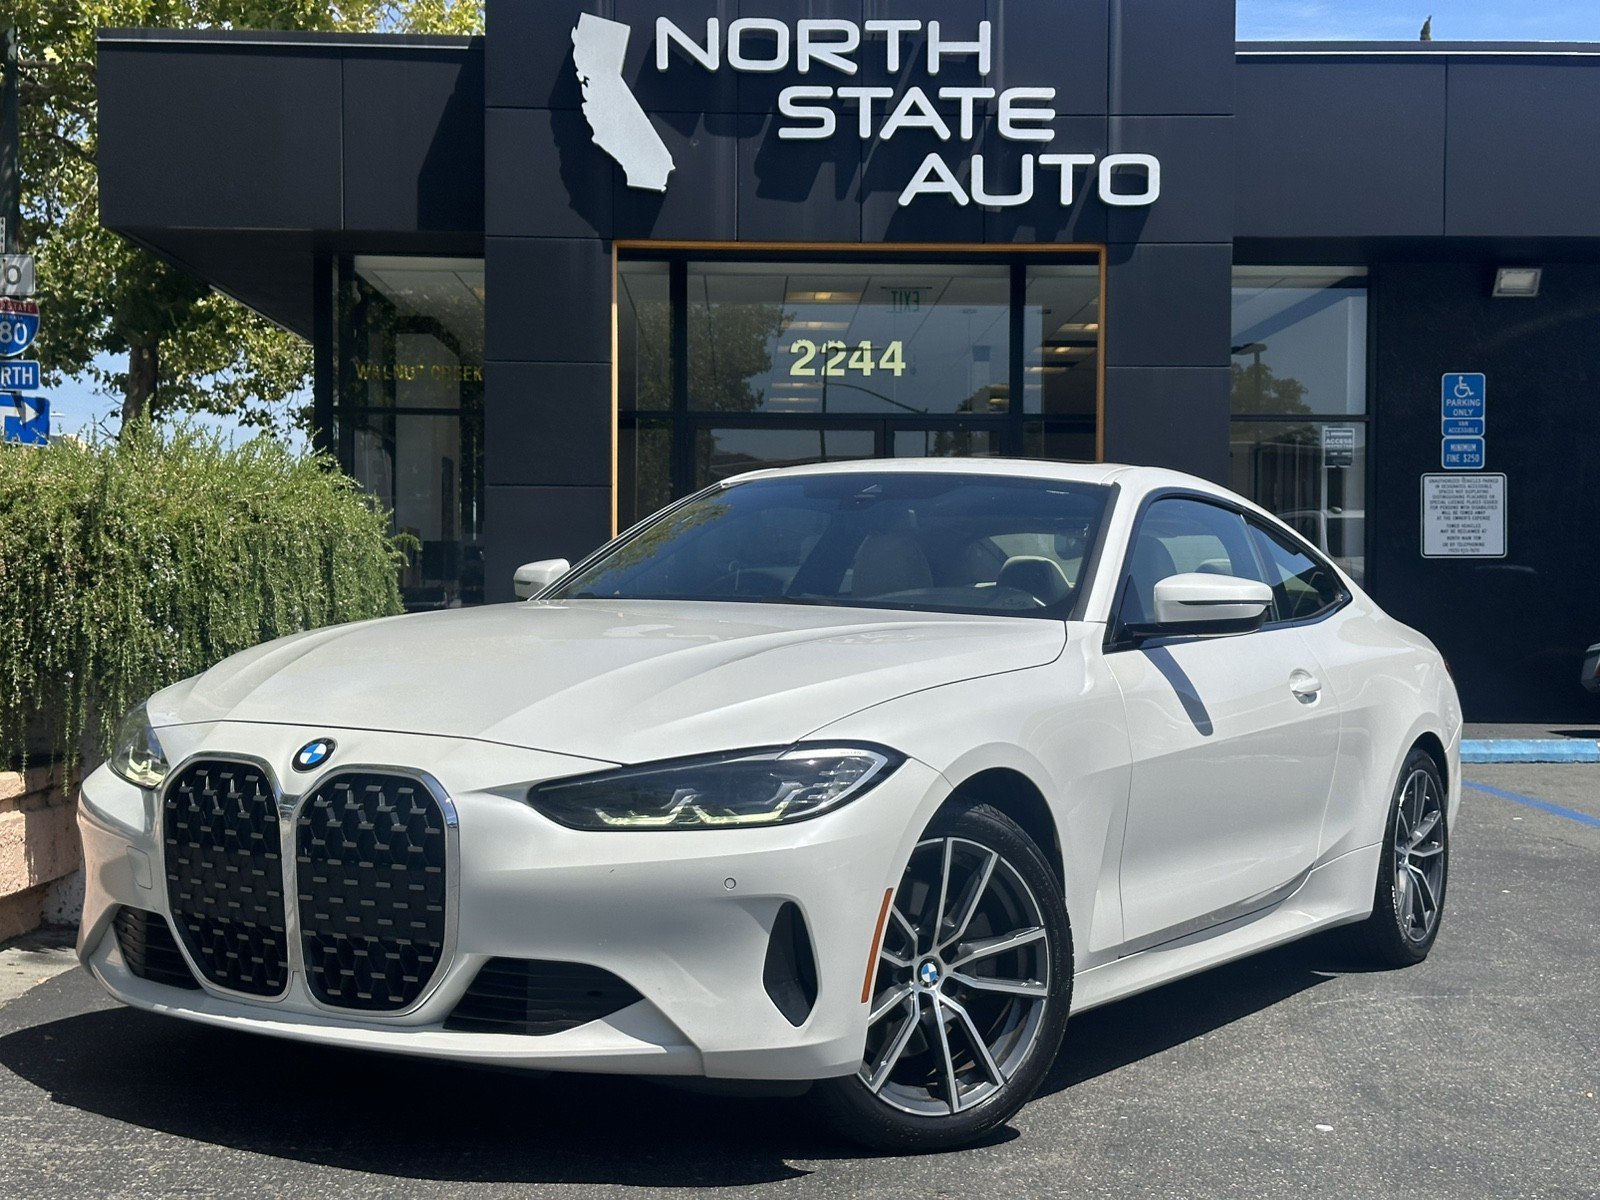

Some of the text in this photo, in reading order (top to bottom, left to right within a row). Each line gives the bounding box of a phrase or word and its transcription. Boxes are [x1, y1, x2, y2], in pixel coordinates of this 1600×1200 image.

[655, 16, 992, 76] NORTH
[777, 86, 1057, 142] STATE
[898, 152, 1161, 207] AUTO
[3, 264, 21, 285] O
[0, 320, 27, 344] 80
[789, 338, 906, 376] 2244
[1, 365, 33, 386] RTH
[1446, 398, 1481, 407] PARKING
[1452, 408, 1474, 416] ONLY
[1446, 453, 1480, 463] FINE $250
[1450, 443, 1477, 452] MINIMUM
